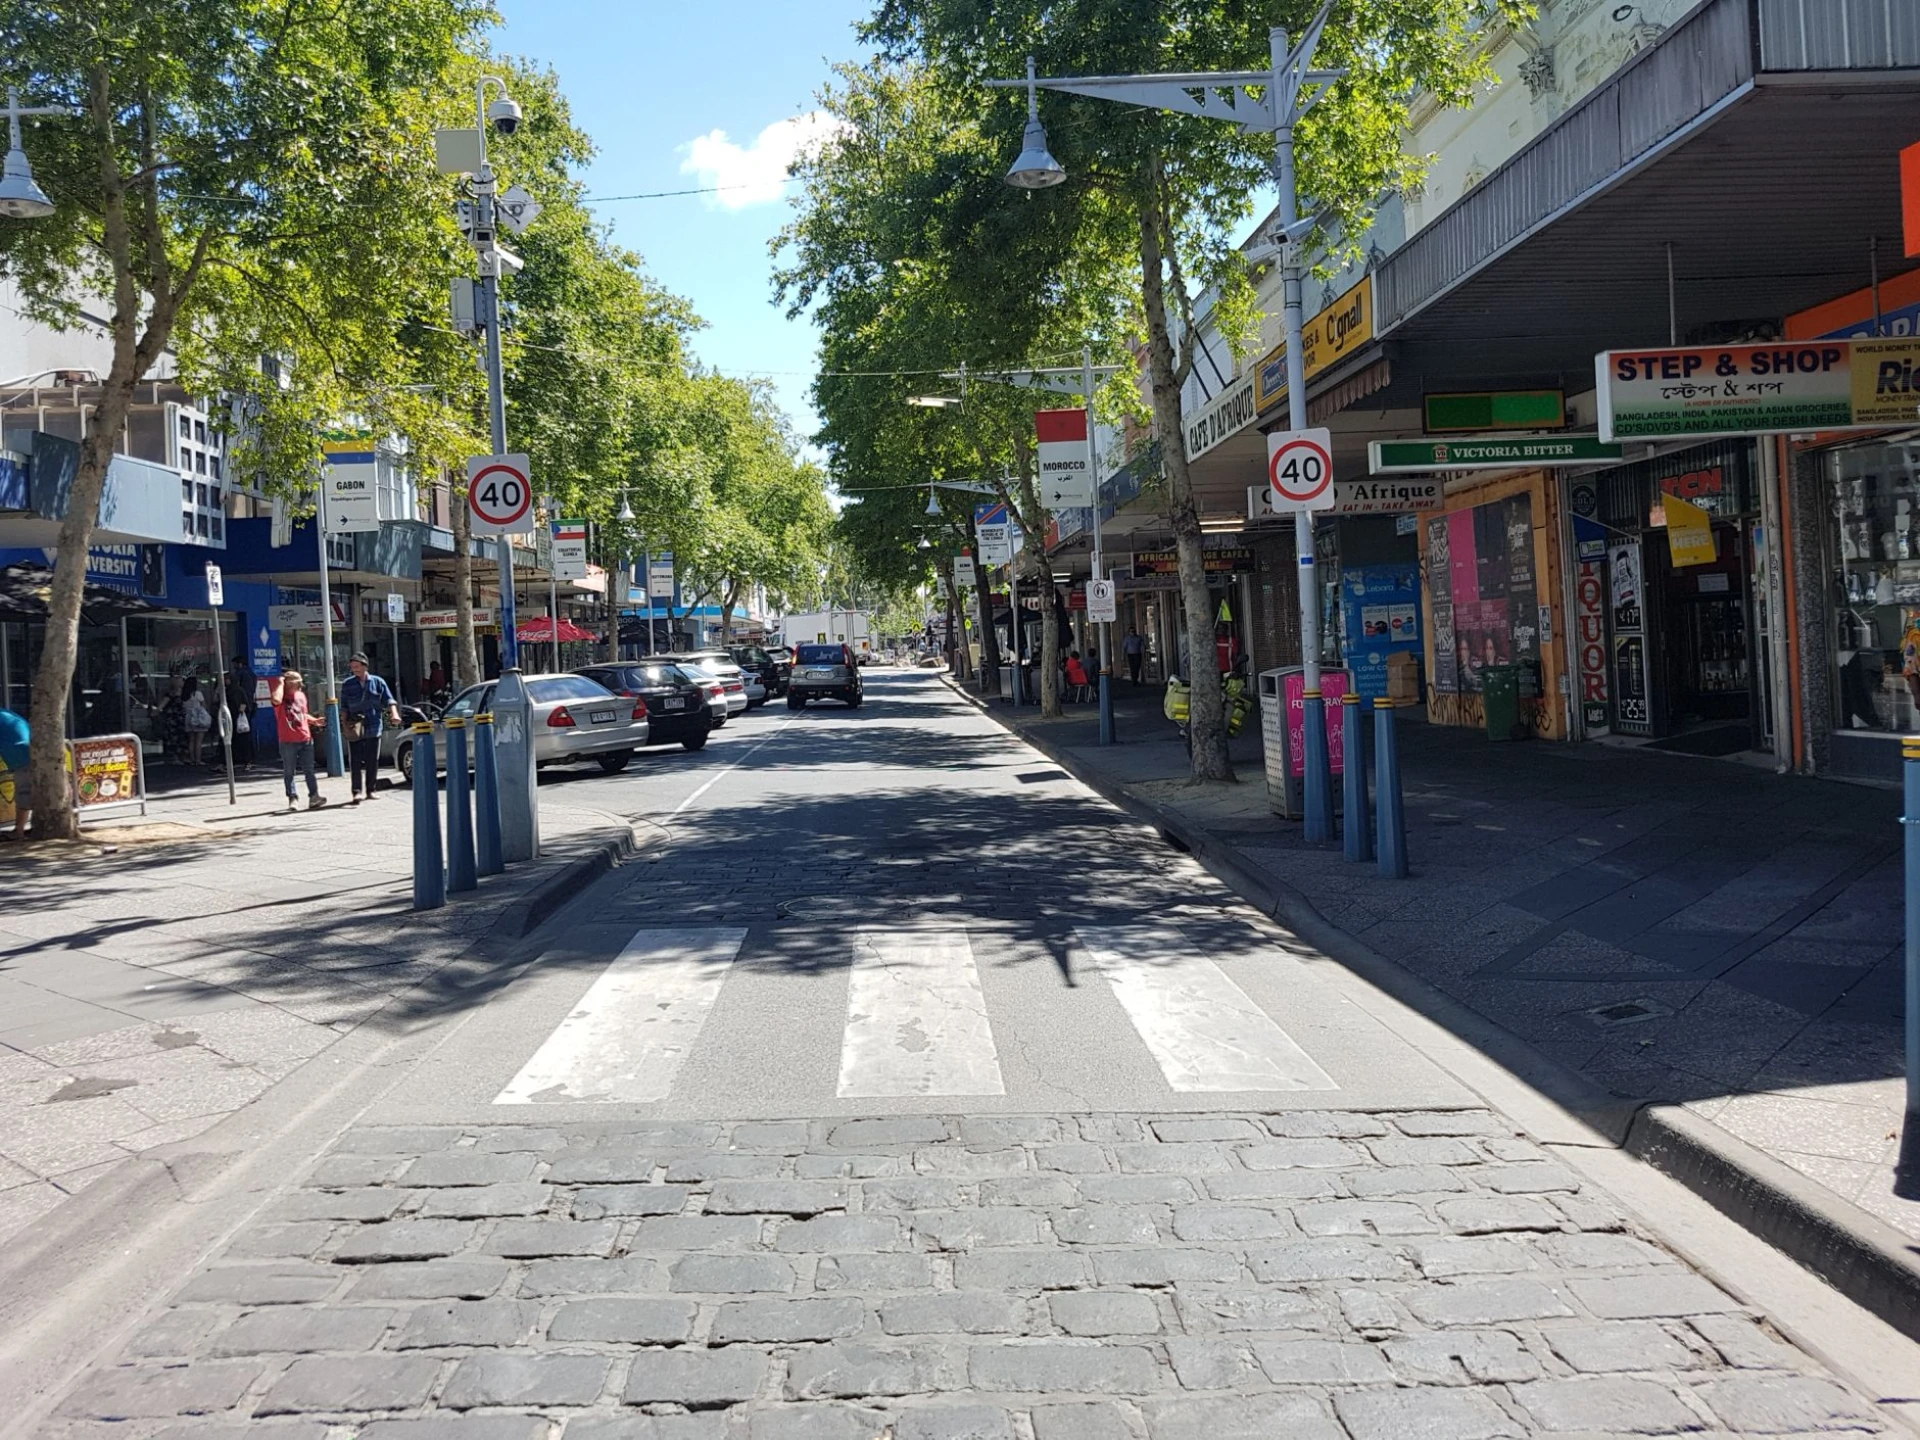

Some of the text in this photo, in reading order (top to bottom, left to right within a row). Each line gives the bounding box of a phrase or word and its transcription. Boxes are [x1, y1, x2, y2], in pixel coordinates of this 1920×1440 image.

[1326, 292, 1362, 352] Cignall
[1856, 345, 1883, 353] WORLD
[1885, 344, 1912, 352] MONEY
[1617, 349, 1841, 381] STEP & SHOP
[1723, 379, 1740, 397] &
[1190, 385, 1254, 455] CAFE D'AFRIQUE
[1615, 411, 1680, 422] BANGLADESH,
[1711, 407, 1754, 417] PAKISTAN
[1766, 405, 1793, 414] ASIAN
[1684, 420, 1709, 431] AND
[1713, 419, 1734, 429] ALL
[1735, 417, 1769, 428] YOUR
[1773, 415, 1809, 426] DESHI
[1811, 413, 1850, 424] NEEDS
[1453, 446, 1521, 459] VICTORIA
[1524, 444, 1574, 456] BITTER
[1043, 461, 1086, 471] MOROCCO
[1281, 456, 1321, 484] 40
[336, 480, 365, 490] GABON
[480, 481, 520, 507] 40
[1343, 504, 1359, 512] EAT
[1362, 503, 1373, 511] IN
[1381, 501, 1404, 510] TAKE
[1409, 500, 1435, 508] AWAY
[1138, 553, 1176, 562] AFRICAN
[473, 613, 489, 621] OUSE
[517, 630, 553, 639] Coca-Cola
[1578, 562, 1607, 701] IQUOR
